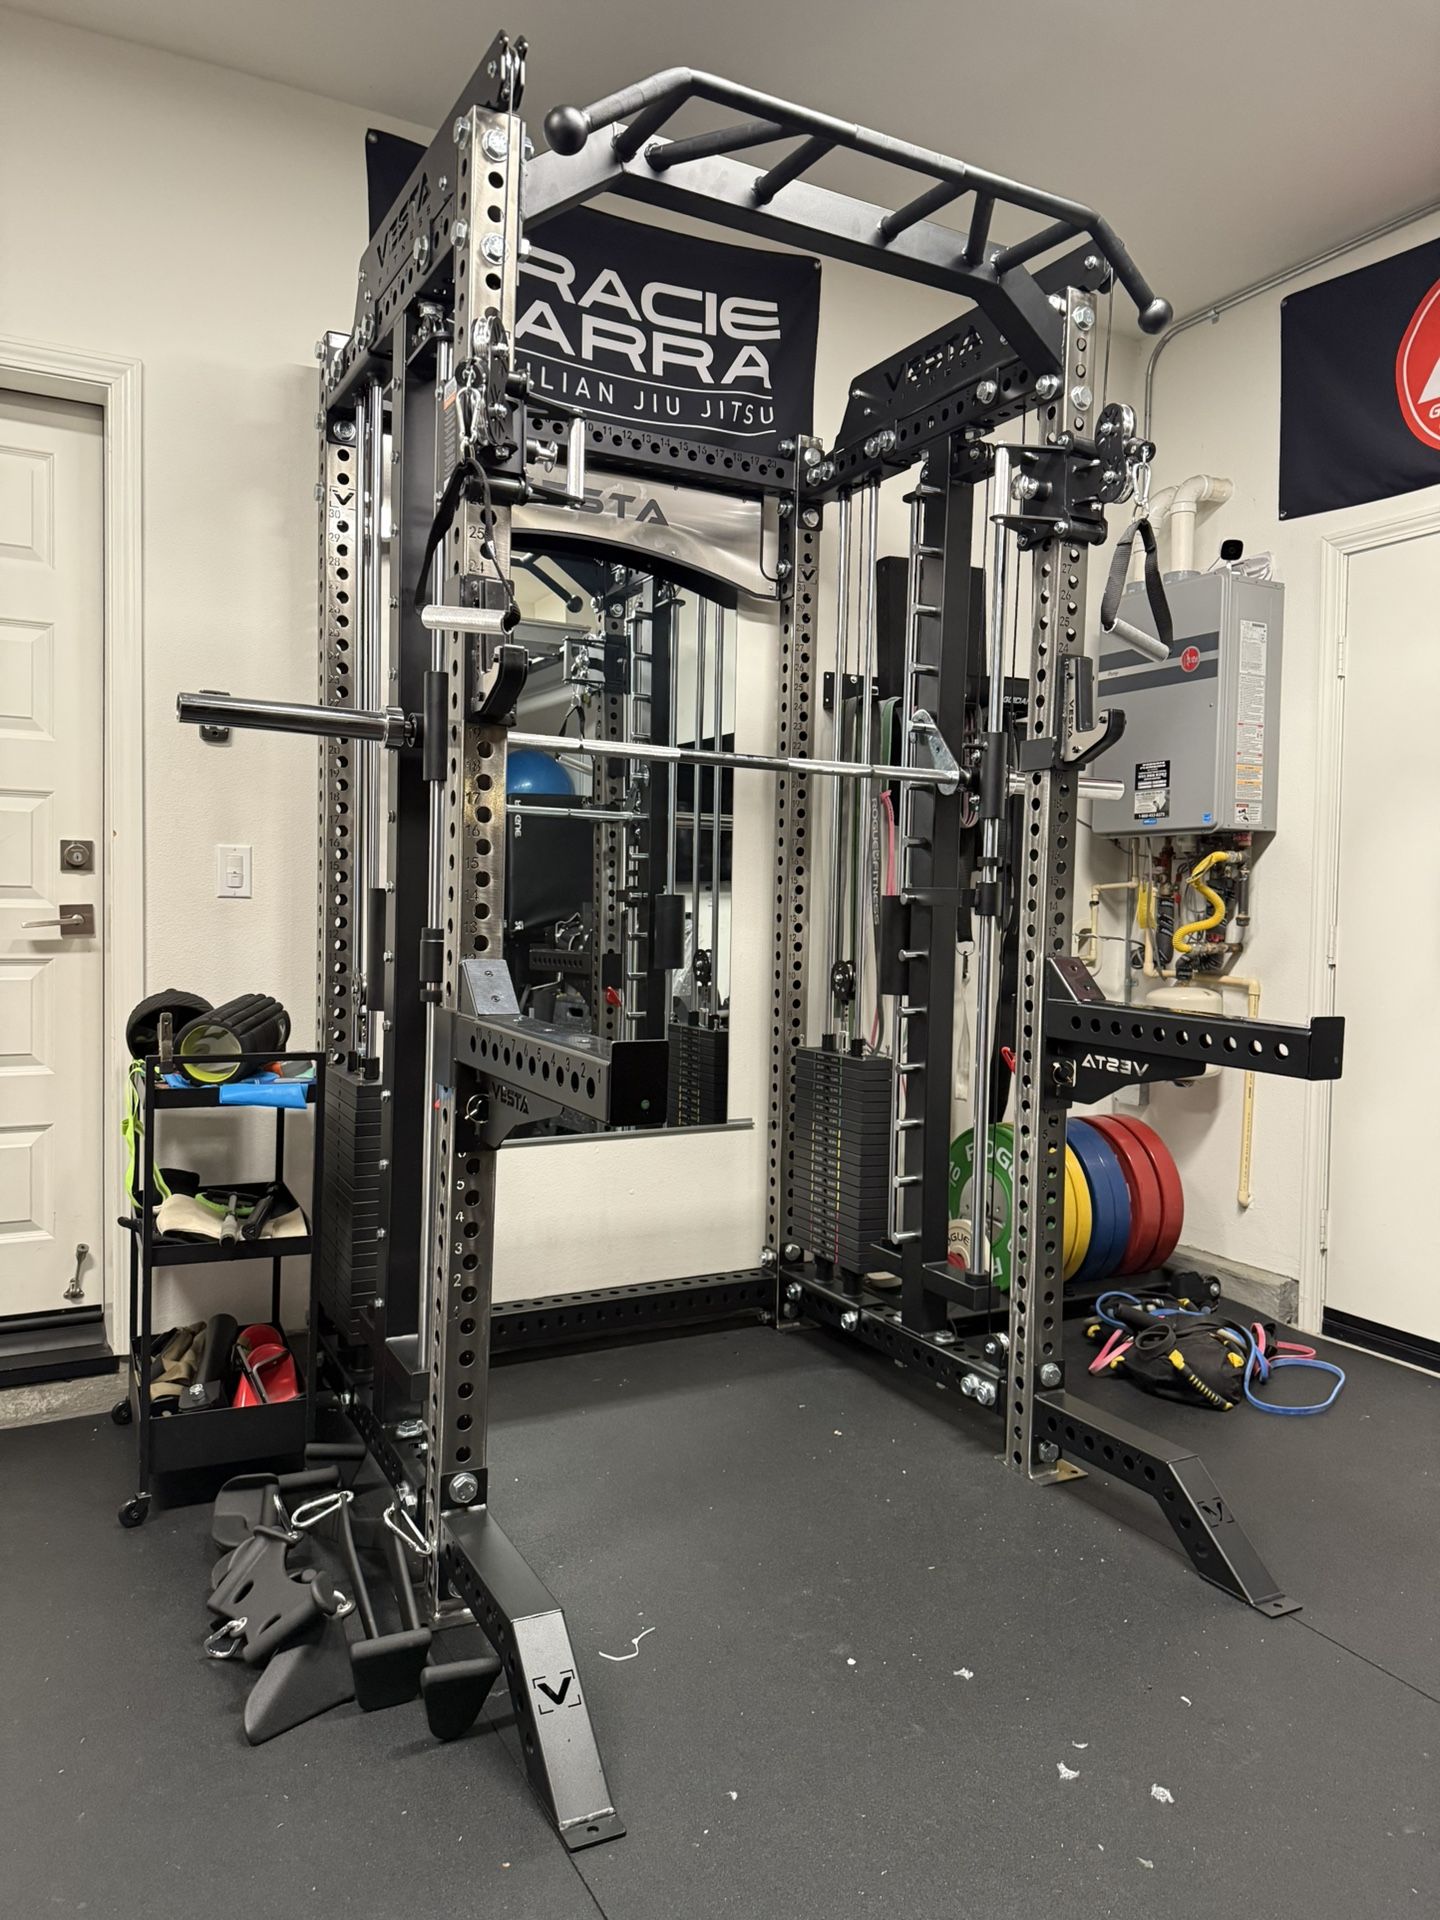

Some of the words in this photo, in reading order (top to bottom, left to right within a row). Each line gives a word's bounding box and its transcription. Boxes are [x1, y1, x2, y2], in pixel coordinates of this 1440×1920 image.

[516, 245, 781, 340] RACIE
[515, 299, 772, 389] ARRA
[633, 391, 681, 416] JIU
[701, 400, 775, 425] JITSU
[328, 509, 341, 519] 30
[328, 533, 341, 543] 29
[468, 526, 485, 539] 25
[328, 557, 341, 567] 28
[491, 1082, 530, 1115] VESTA
[456, 1180, 465, 1190] 5
[455, 1211, 464, 1222] 4
[454, 1242, 463, 1254] 3
[453, 1274, 462, 1287] 2
